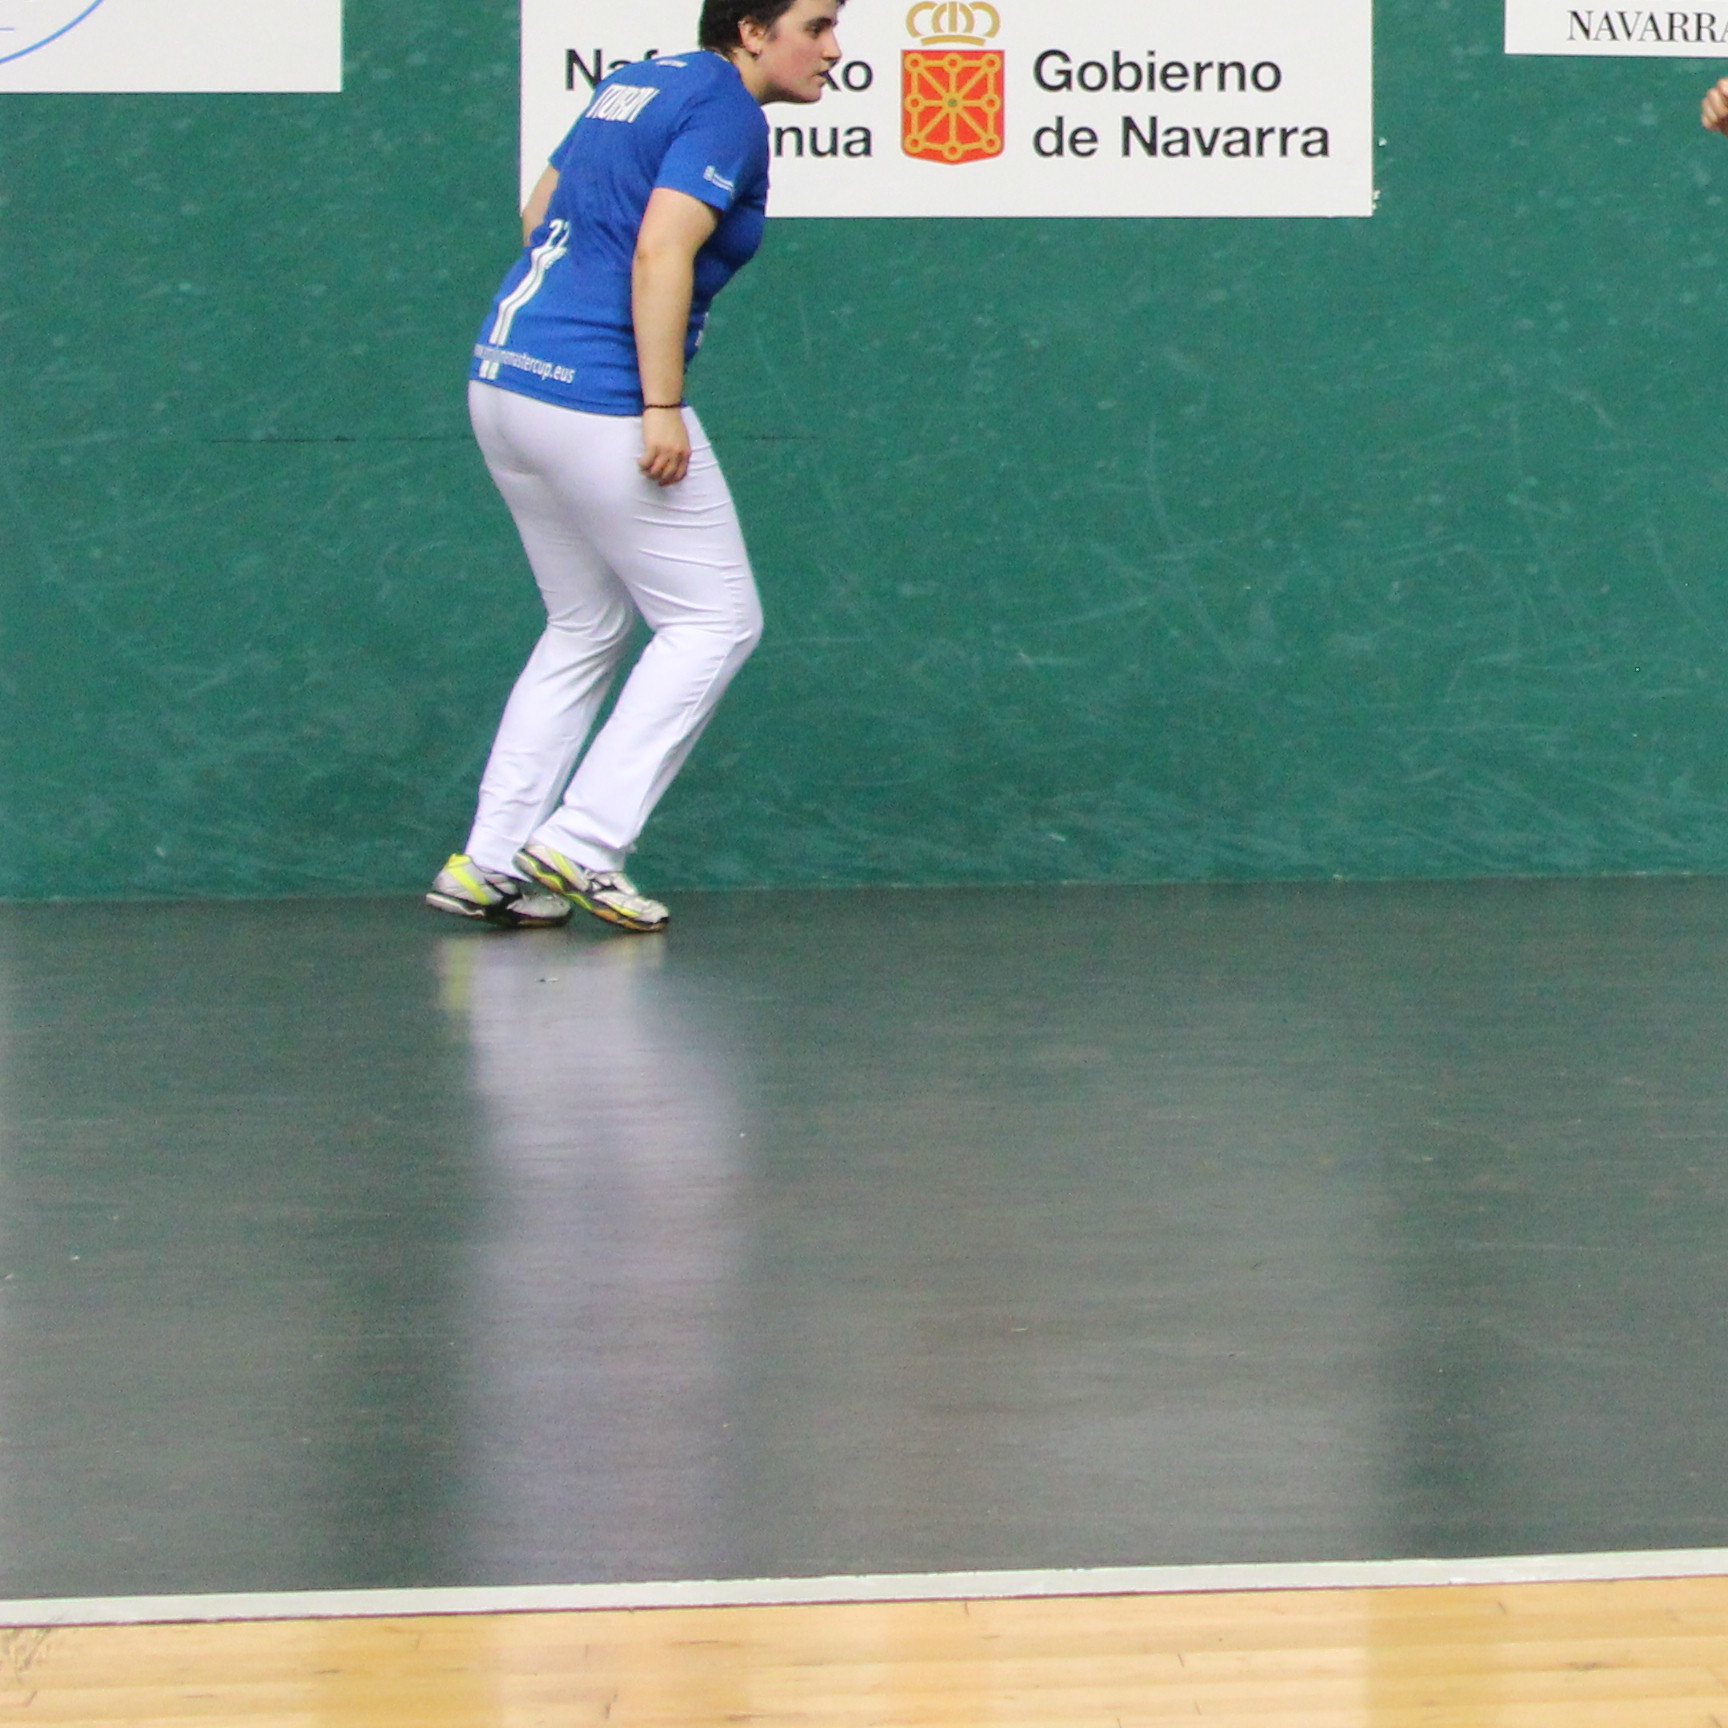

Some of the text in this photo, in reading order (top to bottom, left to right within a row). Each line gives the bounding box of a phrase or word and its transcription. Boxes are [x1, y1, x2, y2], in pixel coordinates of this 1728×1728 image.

[1034, 49, 1281, 92] Gobierno
[1033, 116, 1329, 157] de Navarra
